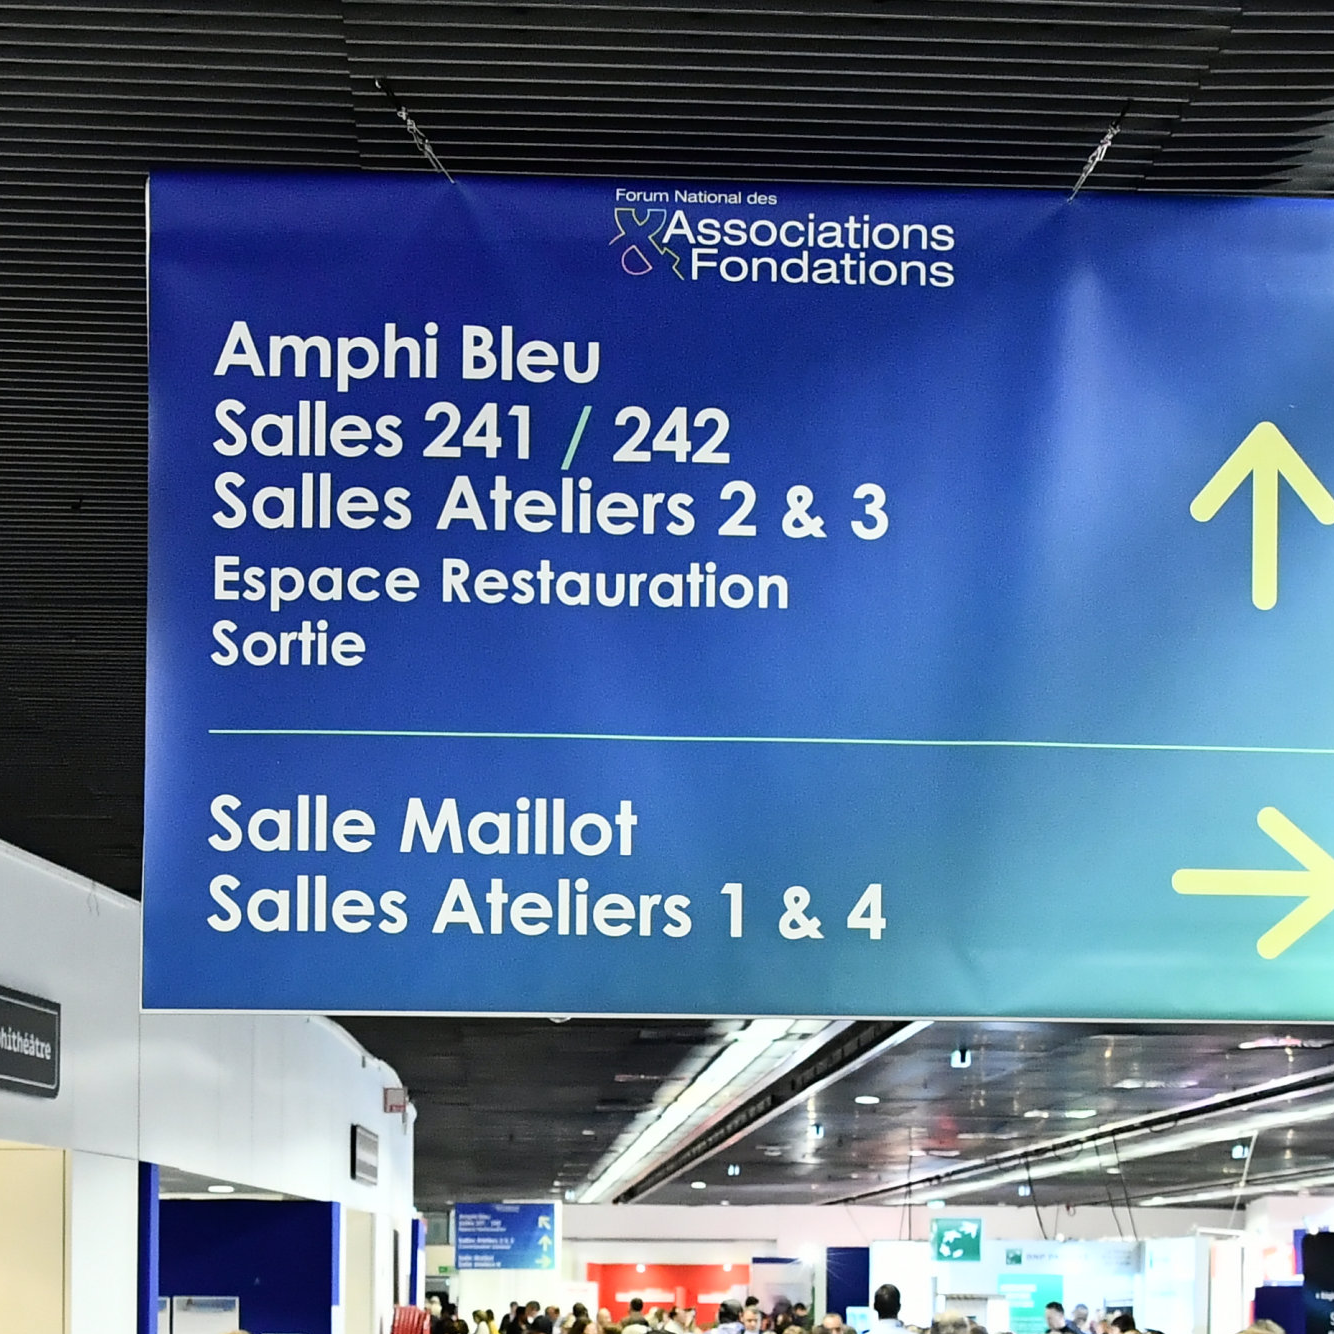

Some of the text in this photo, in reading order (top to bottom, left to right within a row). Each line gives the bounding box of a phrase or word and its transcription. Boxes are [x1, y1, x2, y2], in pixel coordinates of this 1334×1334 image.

[616, 188, 778, 205] Forum National des
[662, 210, 955, 251] Associations
[691, 248, 955, 287] Fondations
[214, 321, 600, 392] Amphi Bleu
[212, 399, 403, 458] Salles
[423, 401, 531, 460] 241
[612, 406, 731, 464] 242
[212, 472, 890, 541] Salles Ateliers 2 & 3
[214, 555, 788, 612] Espace Restauration
[210, 619, 366, 667] Sortie
[208, 795, 638, 857] Salle Maillot
[206, 874, 887, 940] Salles Ateliers 1 & 4
